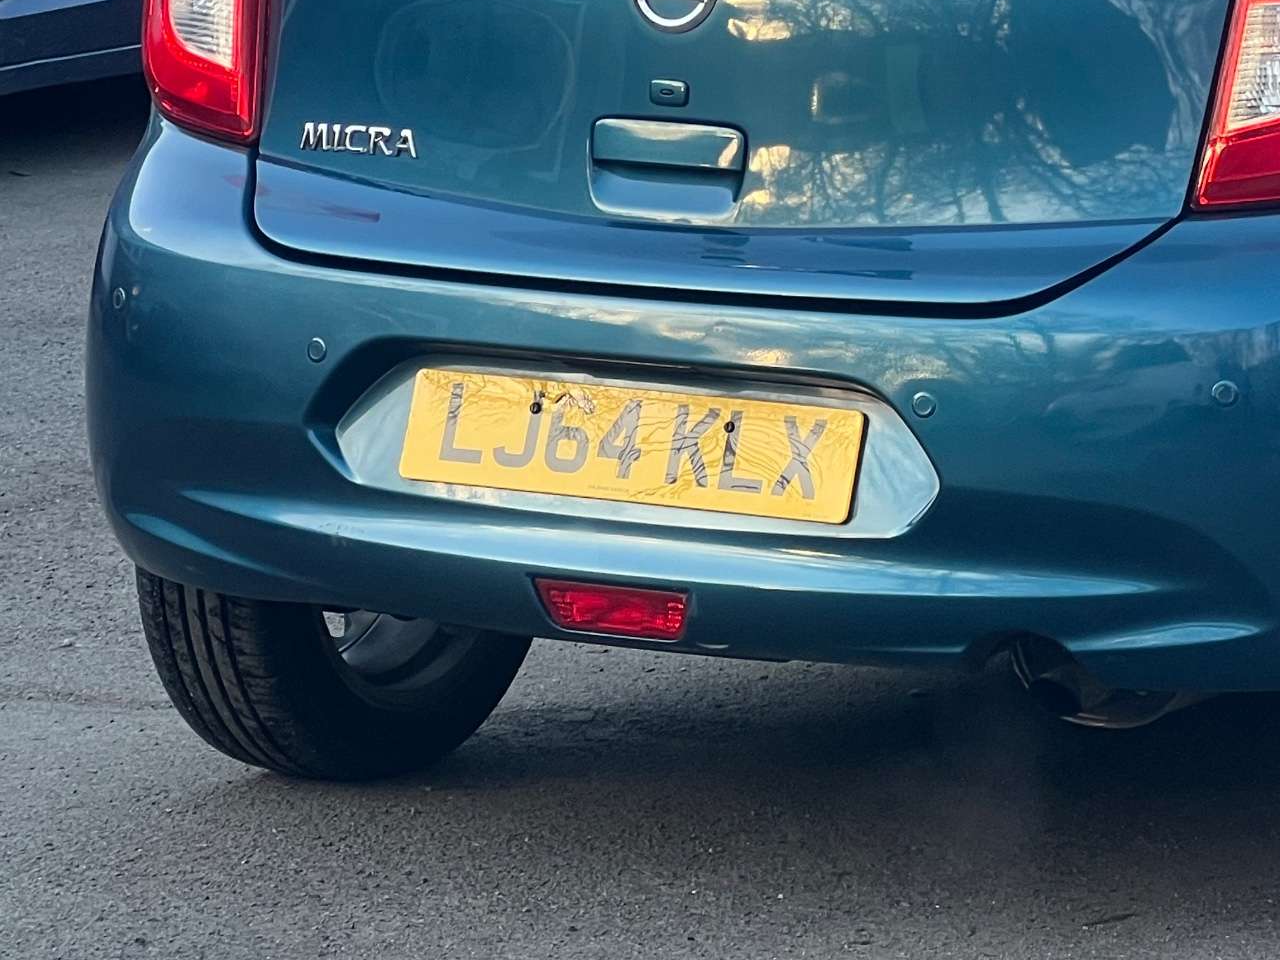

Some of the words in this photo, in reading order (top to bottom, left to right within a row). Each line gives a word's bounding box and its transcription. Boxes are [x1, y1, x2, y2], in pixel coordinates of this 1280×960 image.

[300, 121, 418, 159] MICRA
[439, 382, 643, 480] LJ64
[665, 404, 828, 500] KLX
